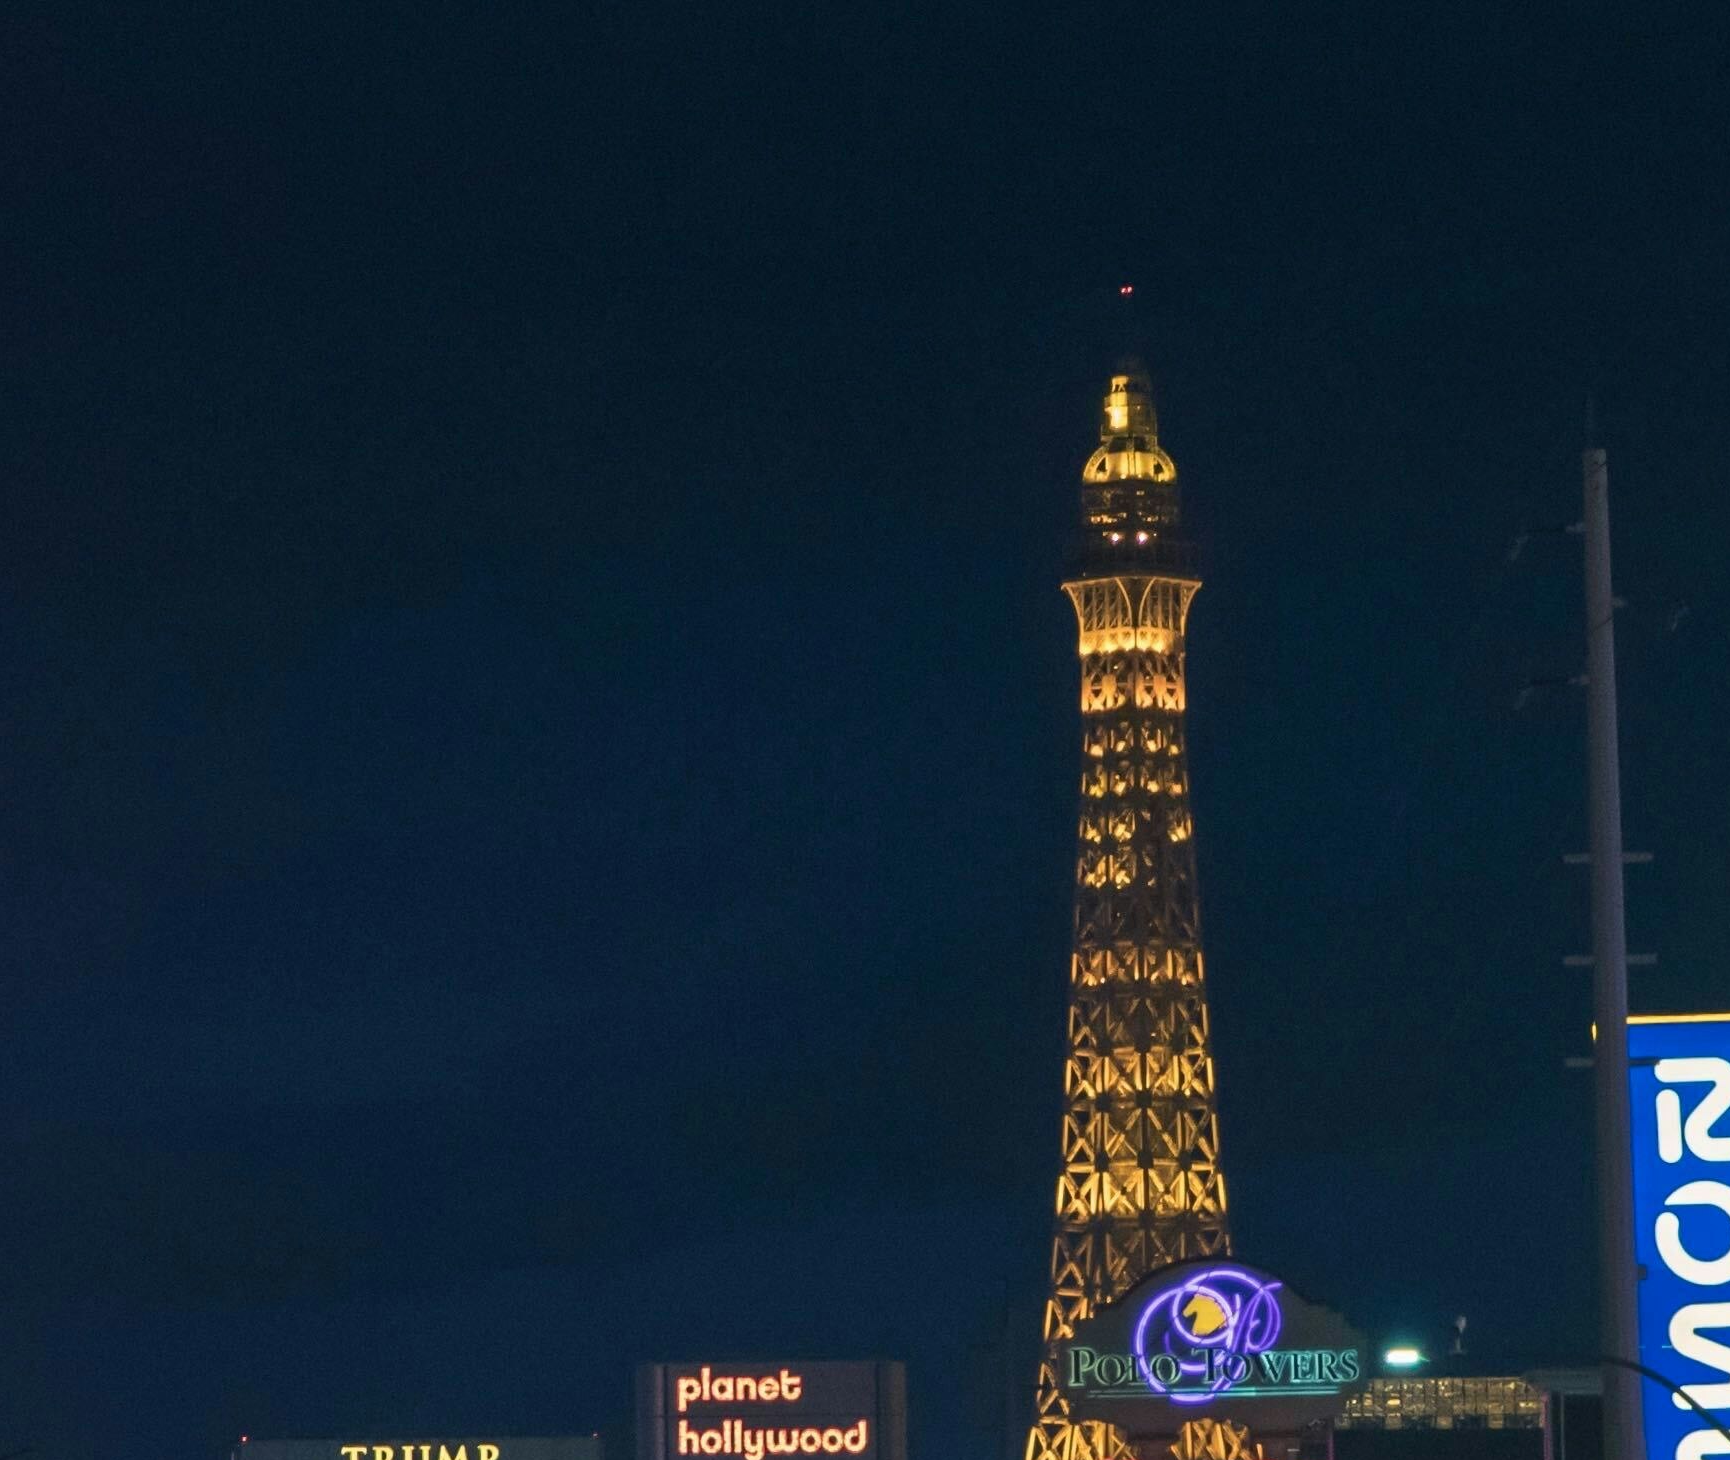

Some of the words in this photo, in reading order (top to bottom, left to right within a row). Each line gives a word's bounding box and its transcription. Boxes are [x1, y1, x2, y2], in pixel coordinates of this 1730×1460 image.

[1070, 1346, 1181, 1386] POLO
[1190, 1346, 1361, 1386] TOWERS
[677, 1366, 803, 1412] planet
